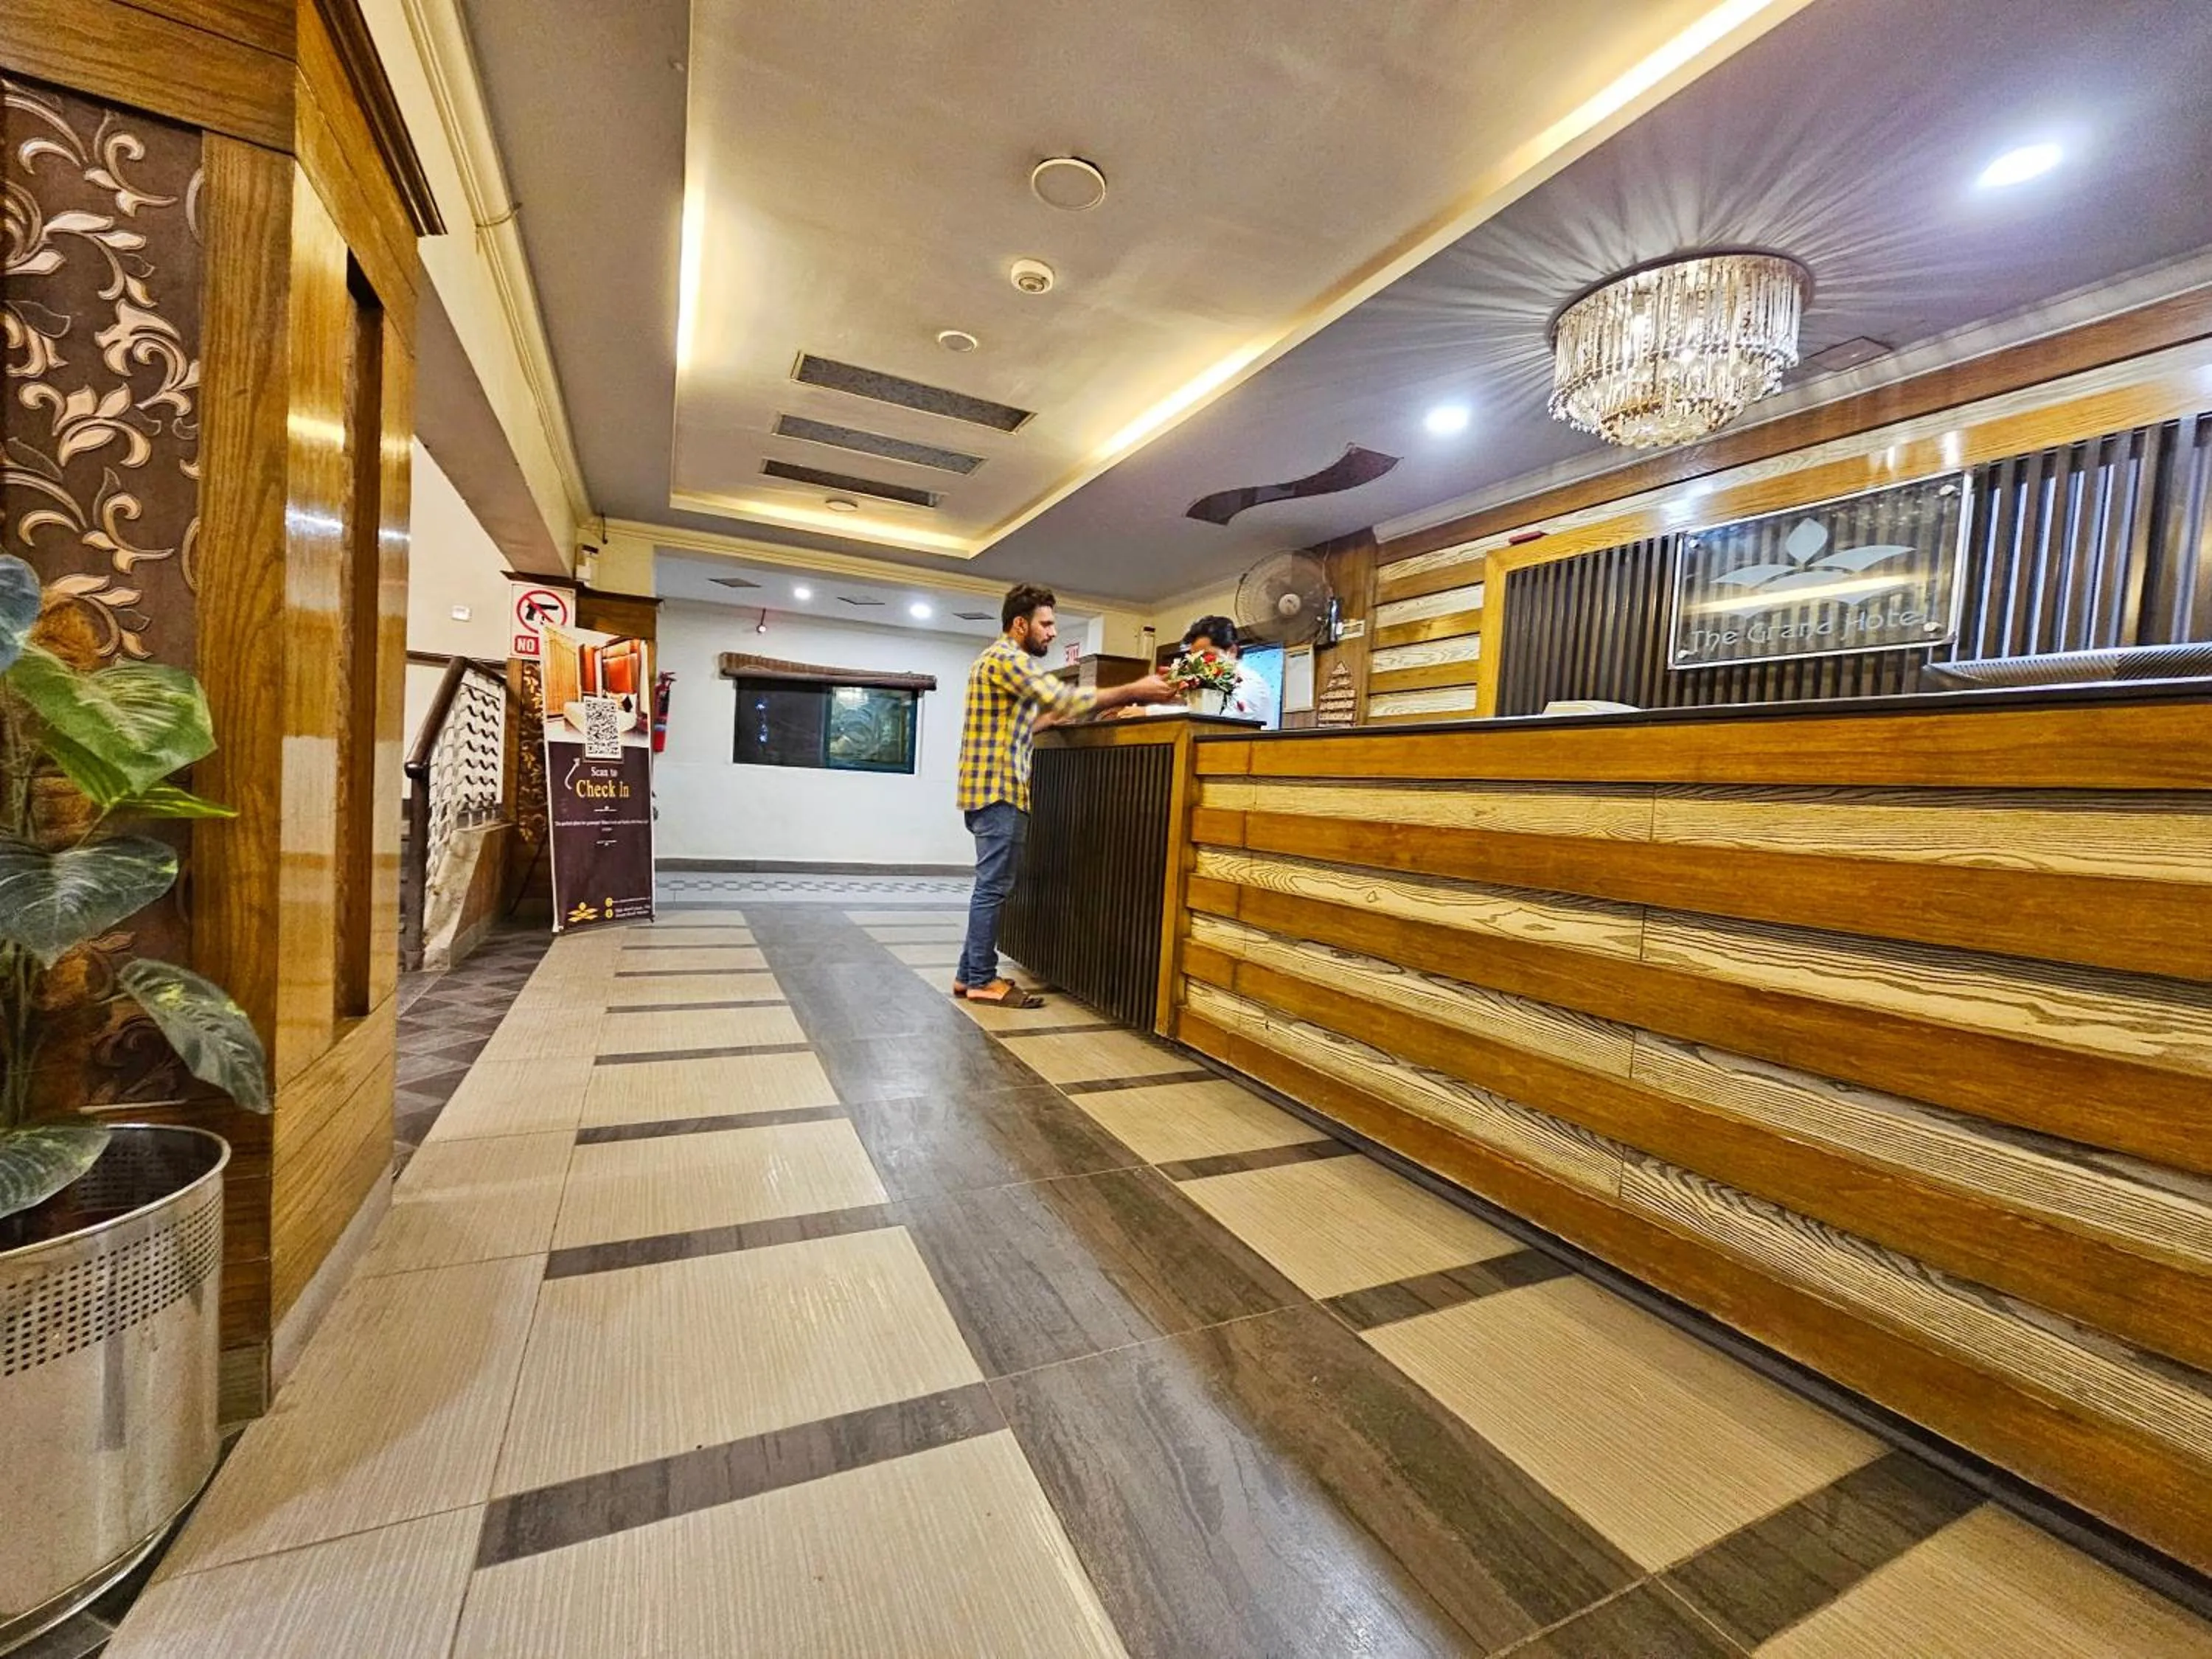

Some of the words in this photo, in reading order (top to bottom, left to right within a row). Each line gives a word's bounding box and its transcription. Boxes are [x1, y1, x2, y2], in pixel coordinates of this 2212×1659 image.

[1691, 626, 1739, 653] The
[1747, 614, 1834, 644] Grand
[517, 638, 535, 653] NO
[591, 766, 608, 777] Scan
[610, 768, 618, 777] to
[576, 779, 616, 798] Check
[619, 780, 630, 798] In
